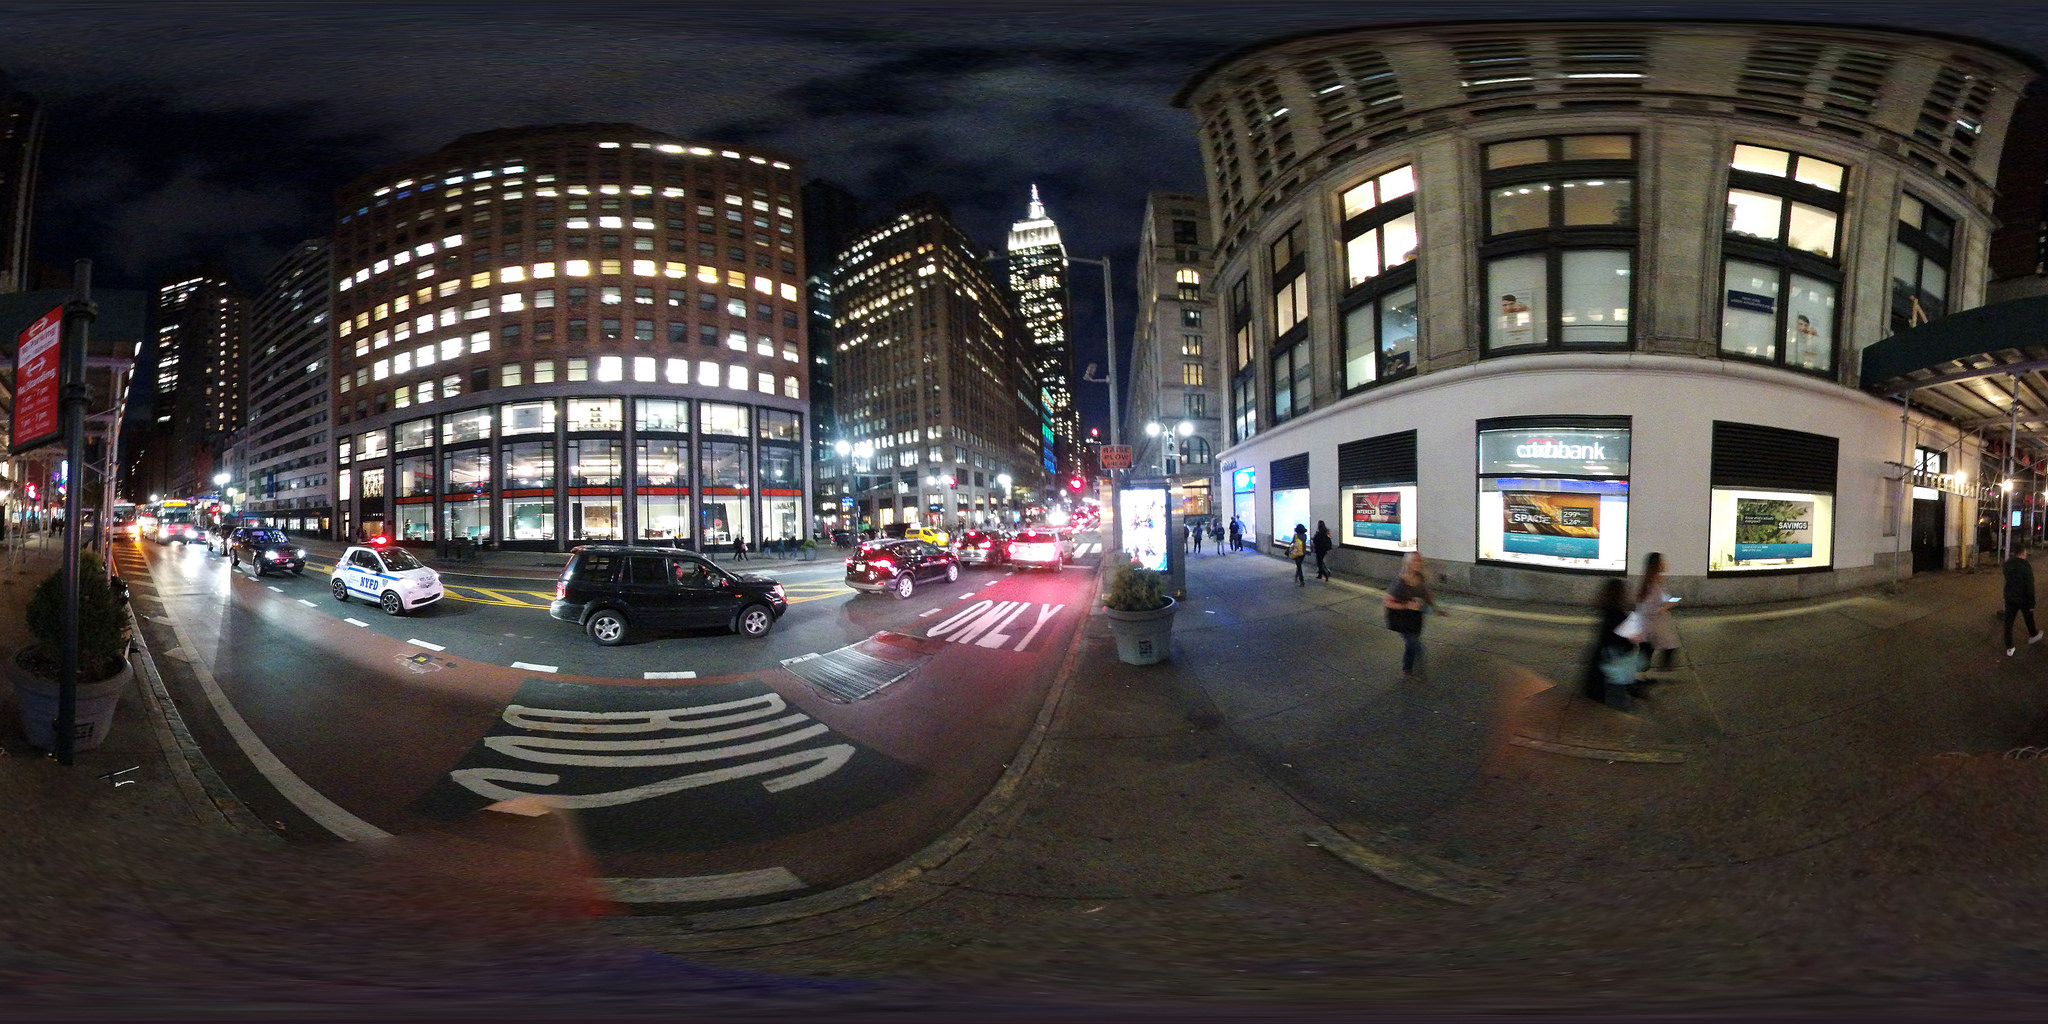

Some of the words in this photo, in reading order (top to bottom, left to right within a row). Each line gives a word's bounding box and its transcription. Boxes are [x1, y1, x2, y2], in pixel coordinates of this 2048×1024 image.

[26, 368, 56, 391] Standing
[1514, 513, 1551, 524] SPACE
[1778, 521, 1808, 529] SAVINGS
[927, 600, 1065, 652] ONLY
[450, 693, 856, 809] BUS
